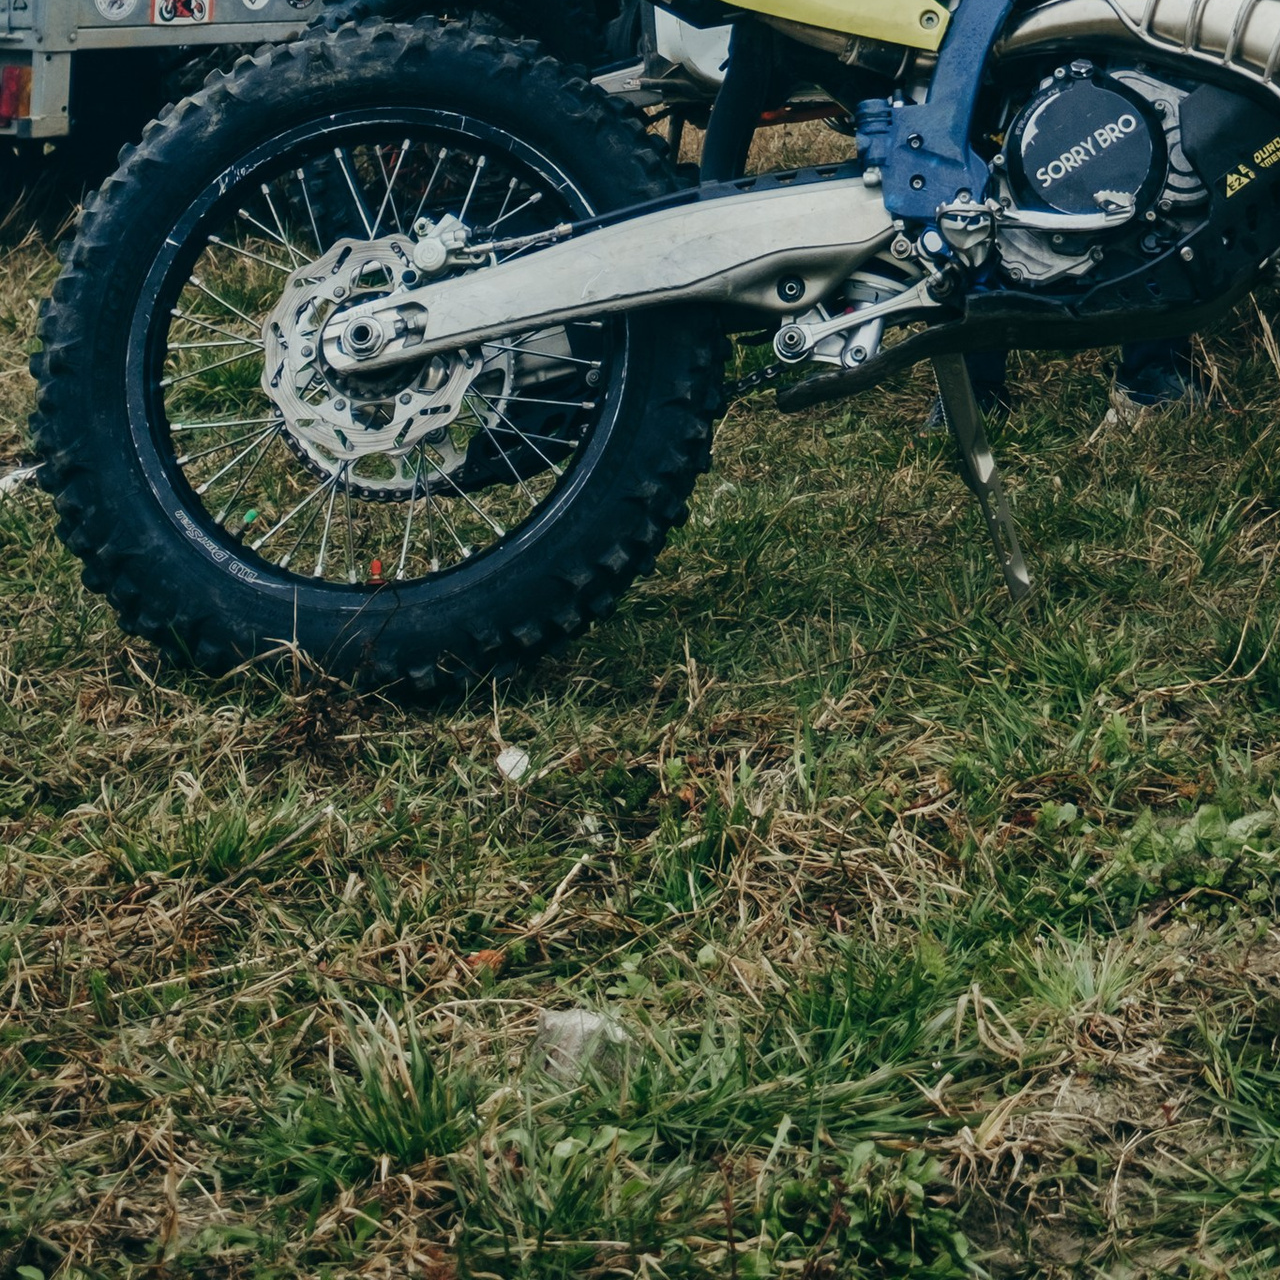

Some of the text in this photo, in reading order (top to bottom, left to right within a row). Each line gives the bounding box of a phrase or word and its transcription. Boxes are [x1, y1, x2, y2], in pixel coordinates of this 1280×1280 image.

[1036, 114, 1137, 188] SORRY BRO
[1227, 176, 1245, 192] E2
